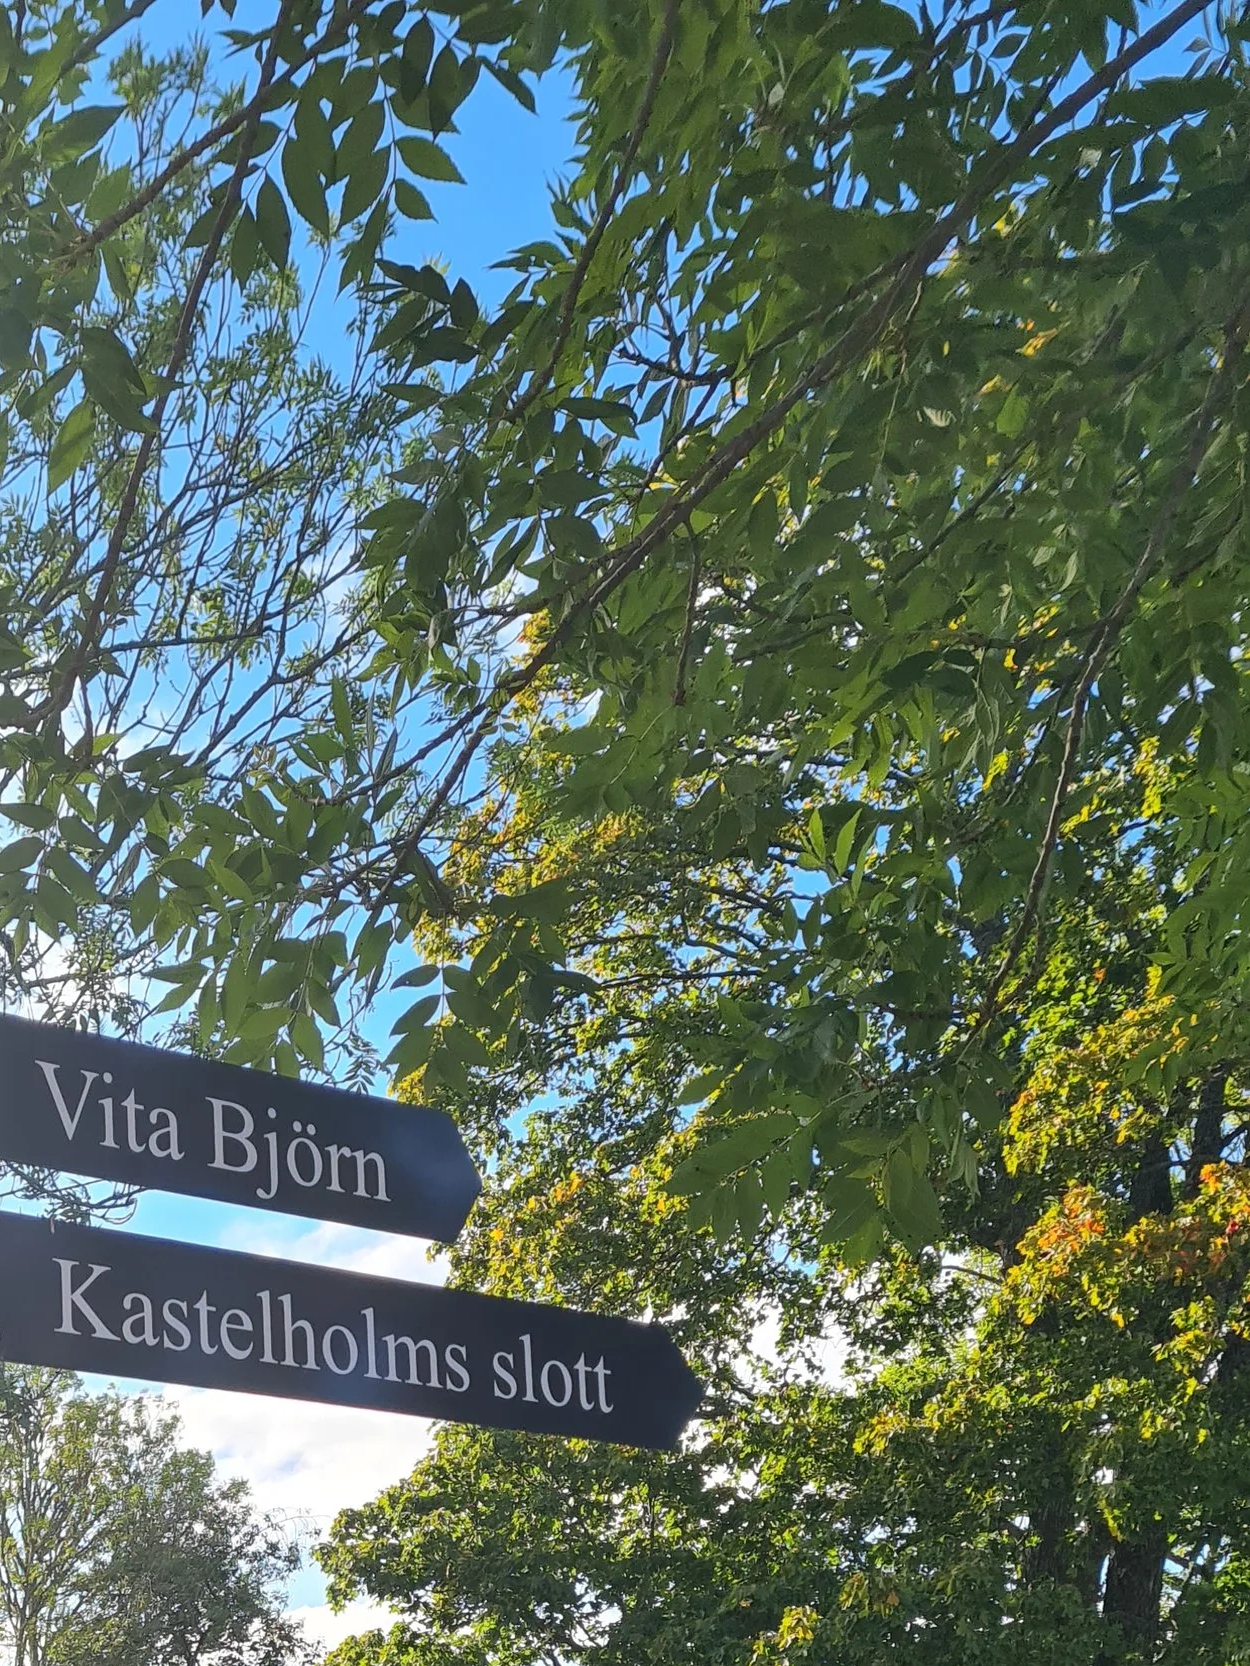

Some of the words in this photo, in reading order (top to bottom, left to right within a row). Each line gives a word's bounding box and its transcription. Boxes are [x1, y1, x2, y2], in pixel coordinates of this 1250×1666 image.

[35, 1059, 184, 1162] Vita
[206, 1097, 391, 1202] Björn
[51, 1257, 470, 1393] Kastelholms
[492, 1334, 615, 1414] slott
